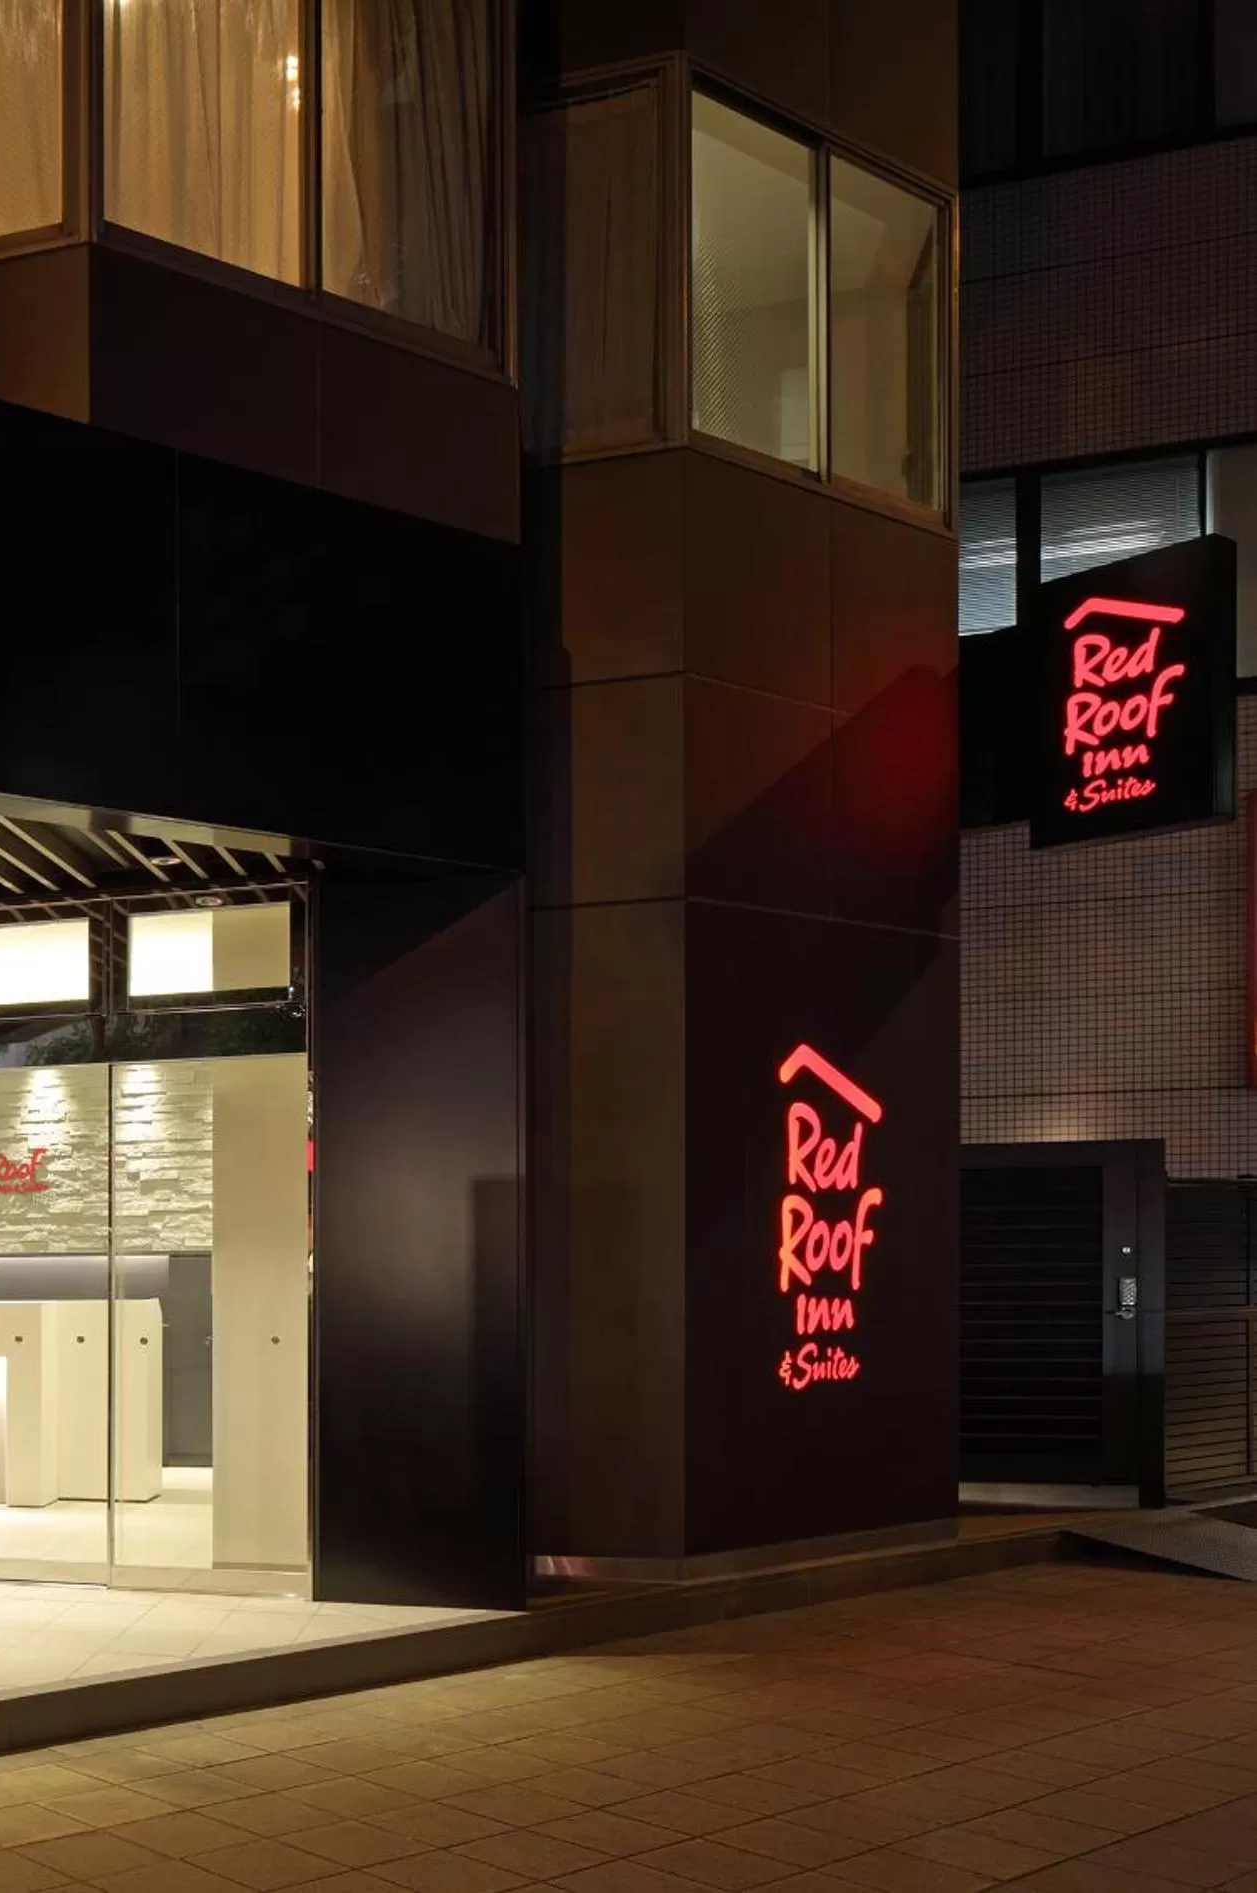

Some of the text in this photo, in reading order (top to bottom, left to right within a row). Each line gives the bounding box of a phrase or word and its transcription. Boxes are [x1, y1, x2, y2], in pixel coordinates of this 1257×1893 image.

[1074, 627, 1160, 688] Red
[1064, 664, 1184, 755] Roof
[1082, 744, 1150, 778] Inn
[788, 1101, 863, 1193] Red
[778, 1187, 883, 1293] Roof
[796, 1293, 855, 1335] Inn
